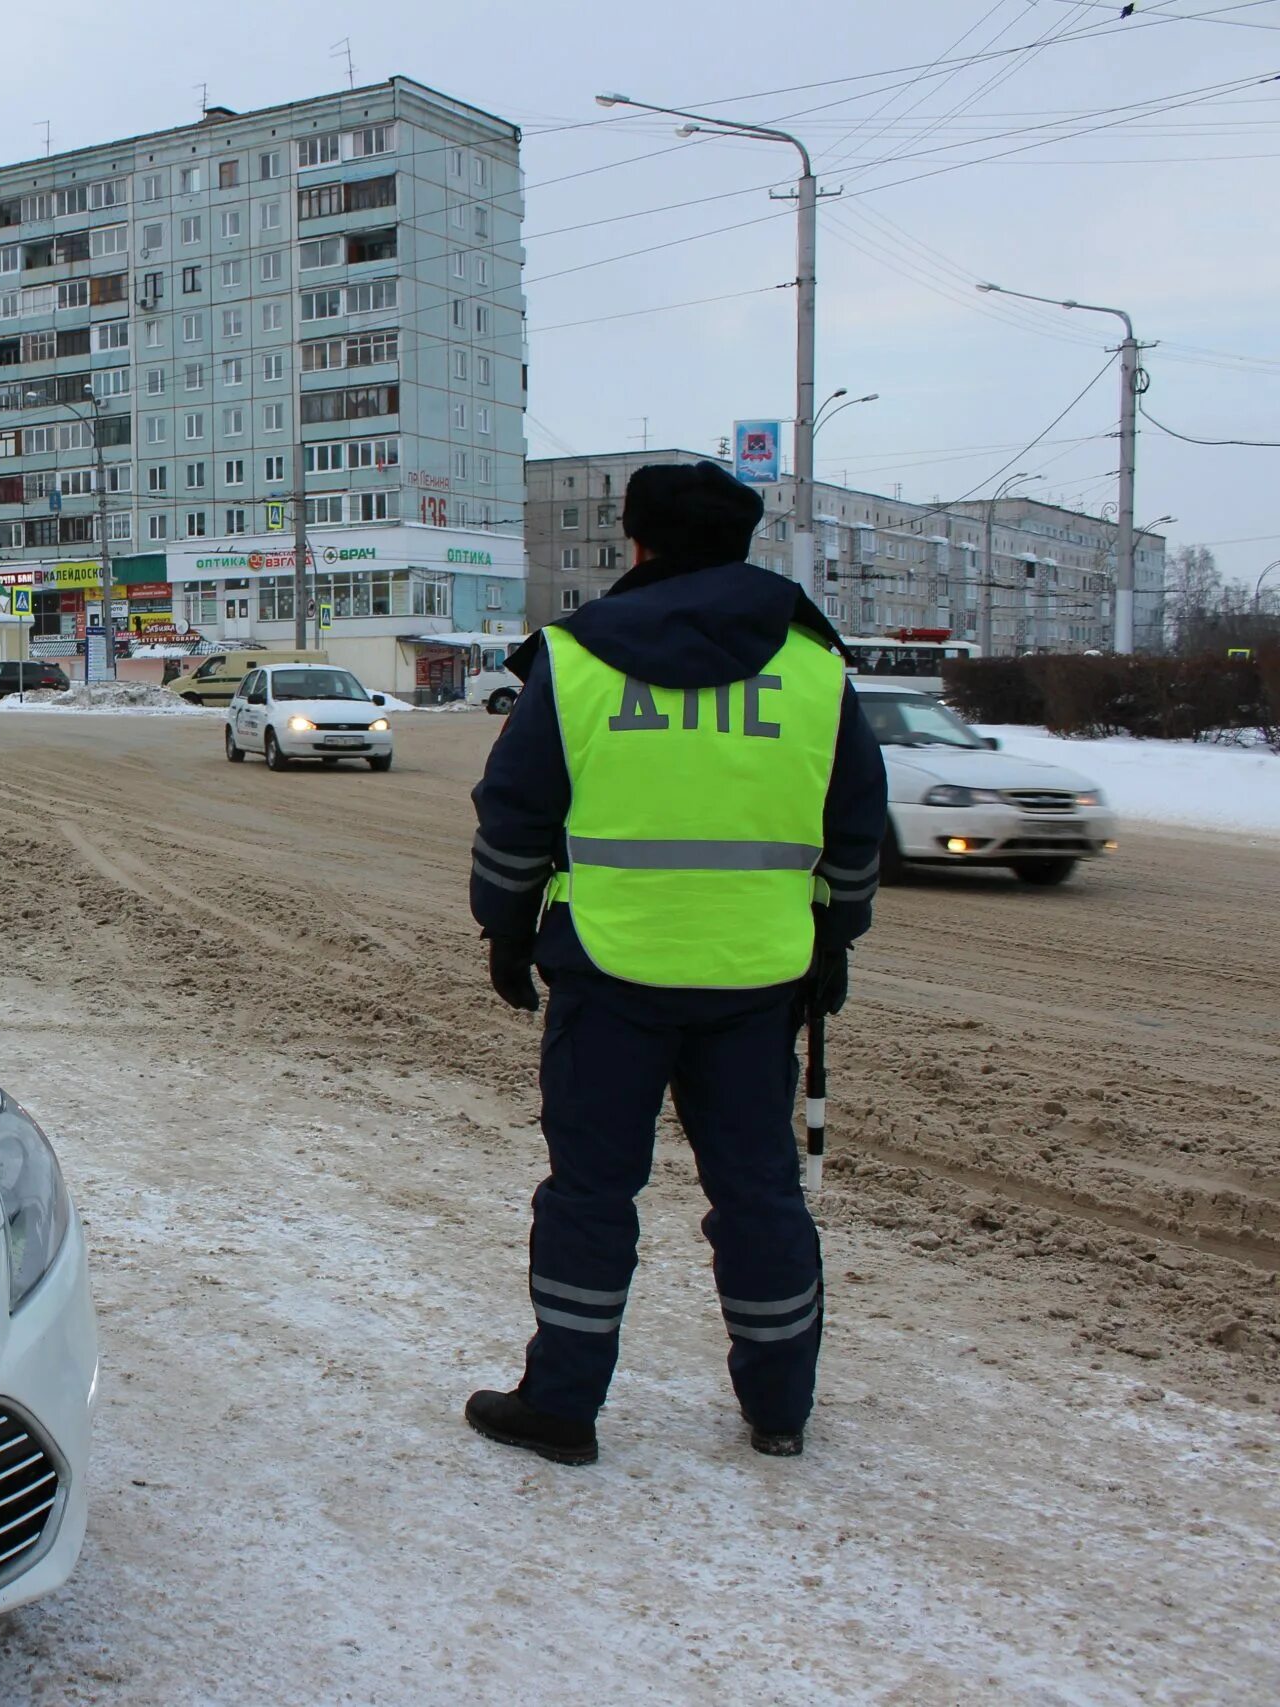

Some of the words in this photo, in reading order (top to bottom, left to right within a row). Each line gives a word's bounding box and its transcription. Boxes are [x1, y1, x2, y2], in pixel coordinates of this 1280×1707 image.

[420, 495, 447, 527] 136
[196, 552, 247, 569] ОПТИКА
[265, 555, 312, 568] ВЗГЛД
[340, 548, 376, 560] ВРАЧ
[447, 548, 492, 566] ОПТИКА
[43, 567, 111, 583] КАЛЕЙДОСКО
[608, 673, 783, 739] ДПС
